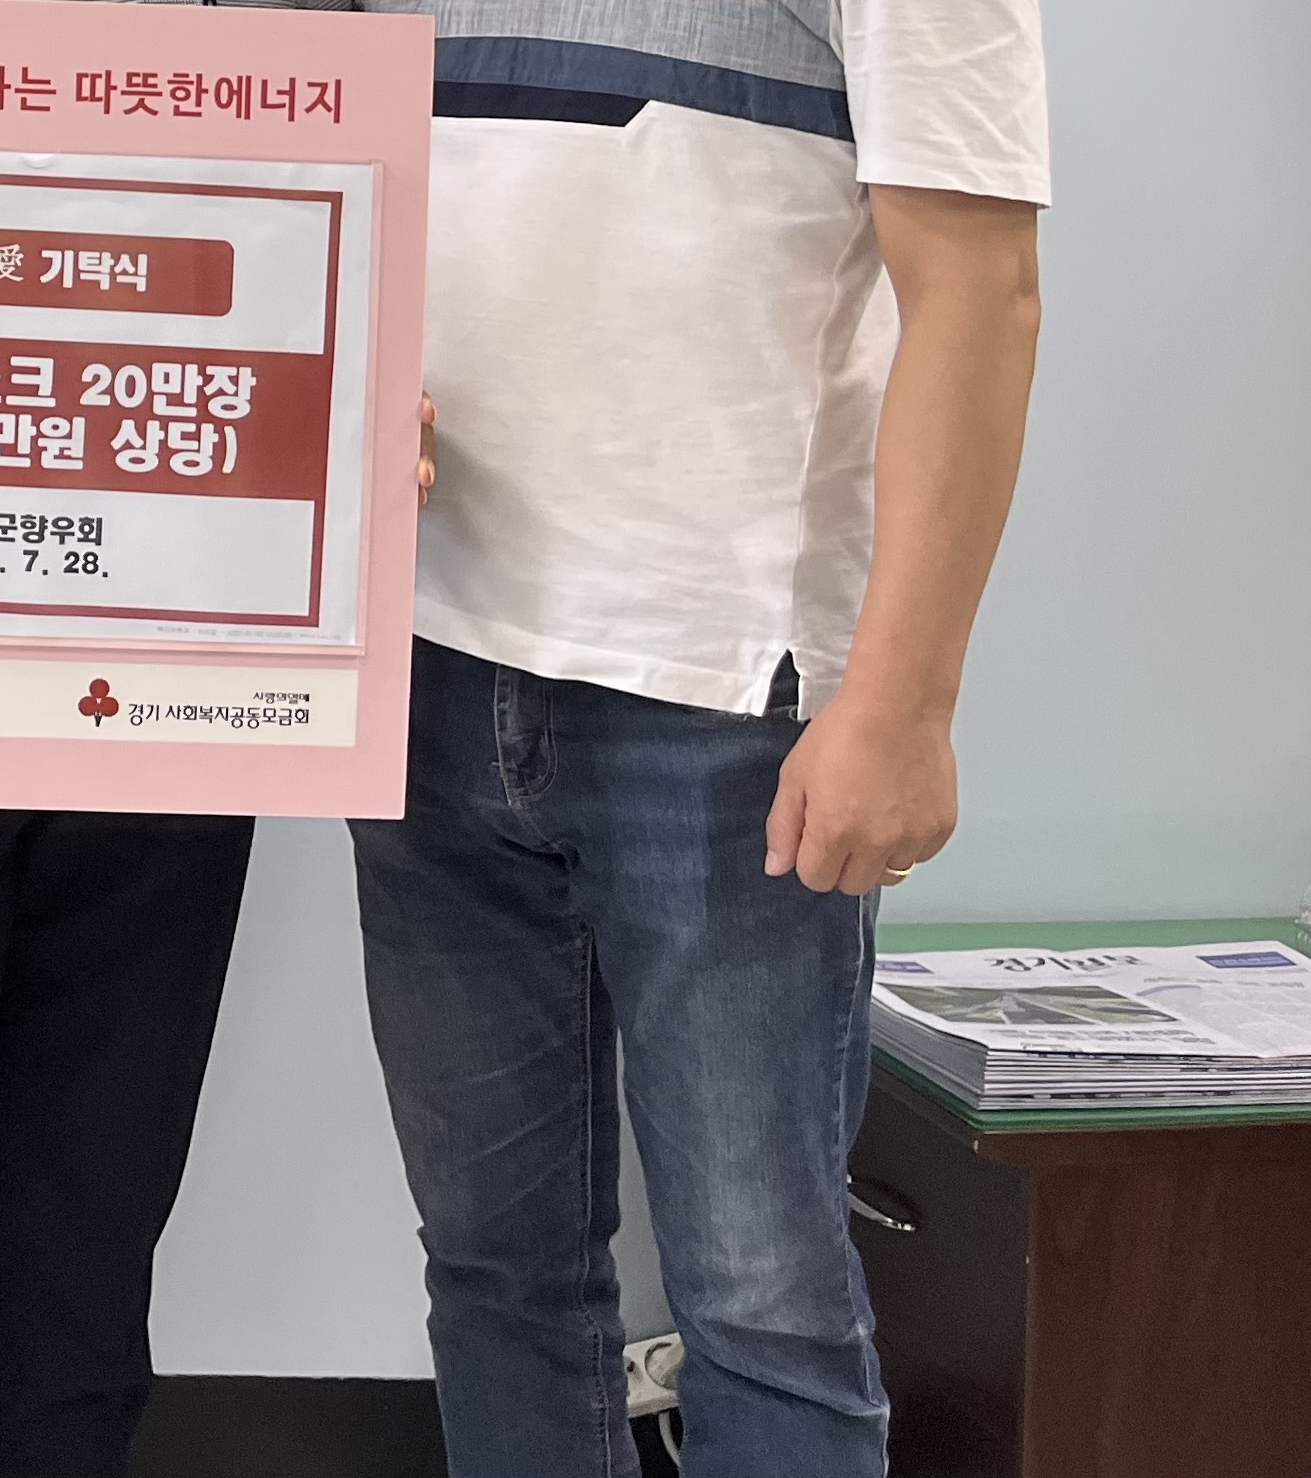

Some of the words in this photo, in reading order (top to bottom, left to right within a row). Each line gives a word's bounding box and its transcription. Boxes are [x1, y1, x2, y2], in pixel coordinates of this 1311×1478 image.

[75, 69, 343, 124] 따뜻한에너지
[39, 249, 148, 292] 기탁식
[79, 362, 257, 420] 20만장
[111, 420, 238, 477] 상당)
[22, 549, 48, 577] 7.
[64, 551, 109, 578] 28.
[128, 704, 159, 726] 경기
[165, 705, 310, 729] 사회복지공동모금회
